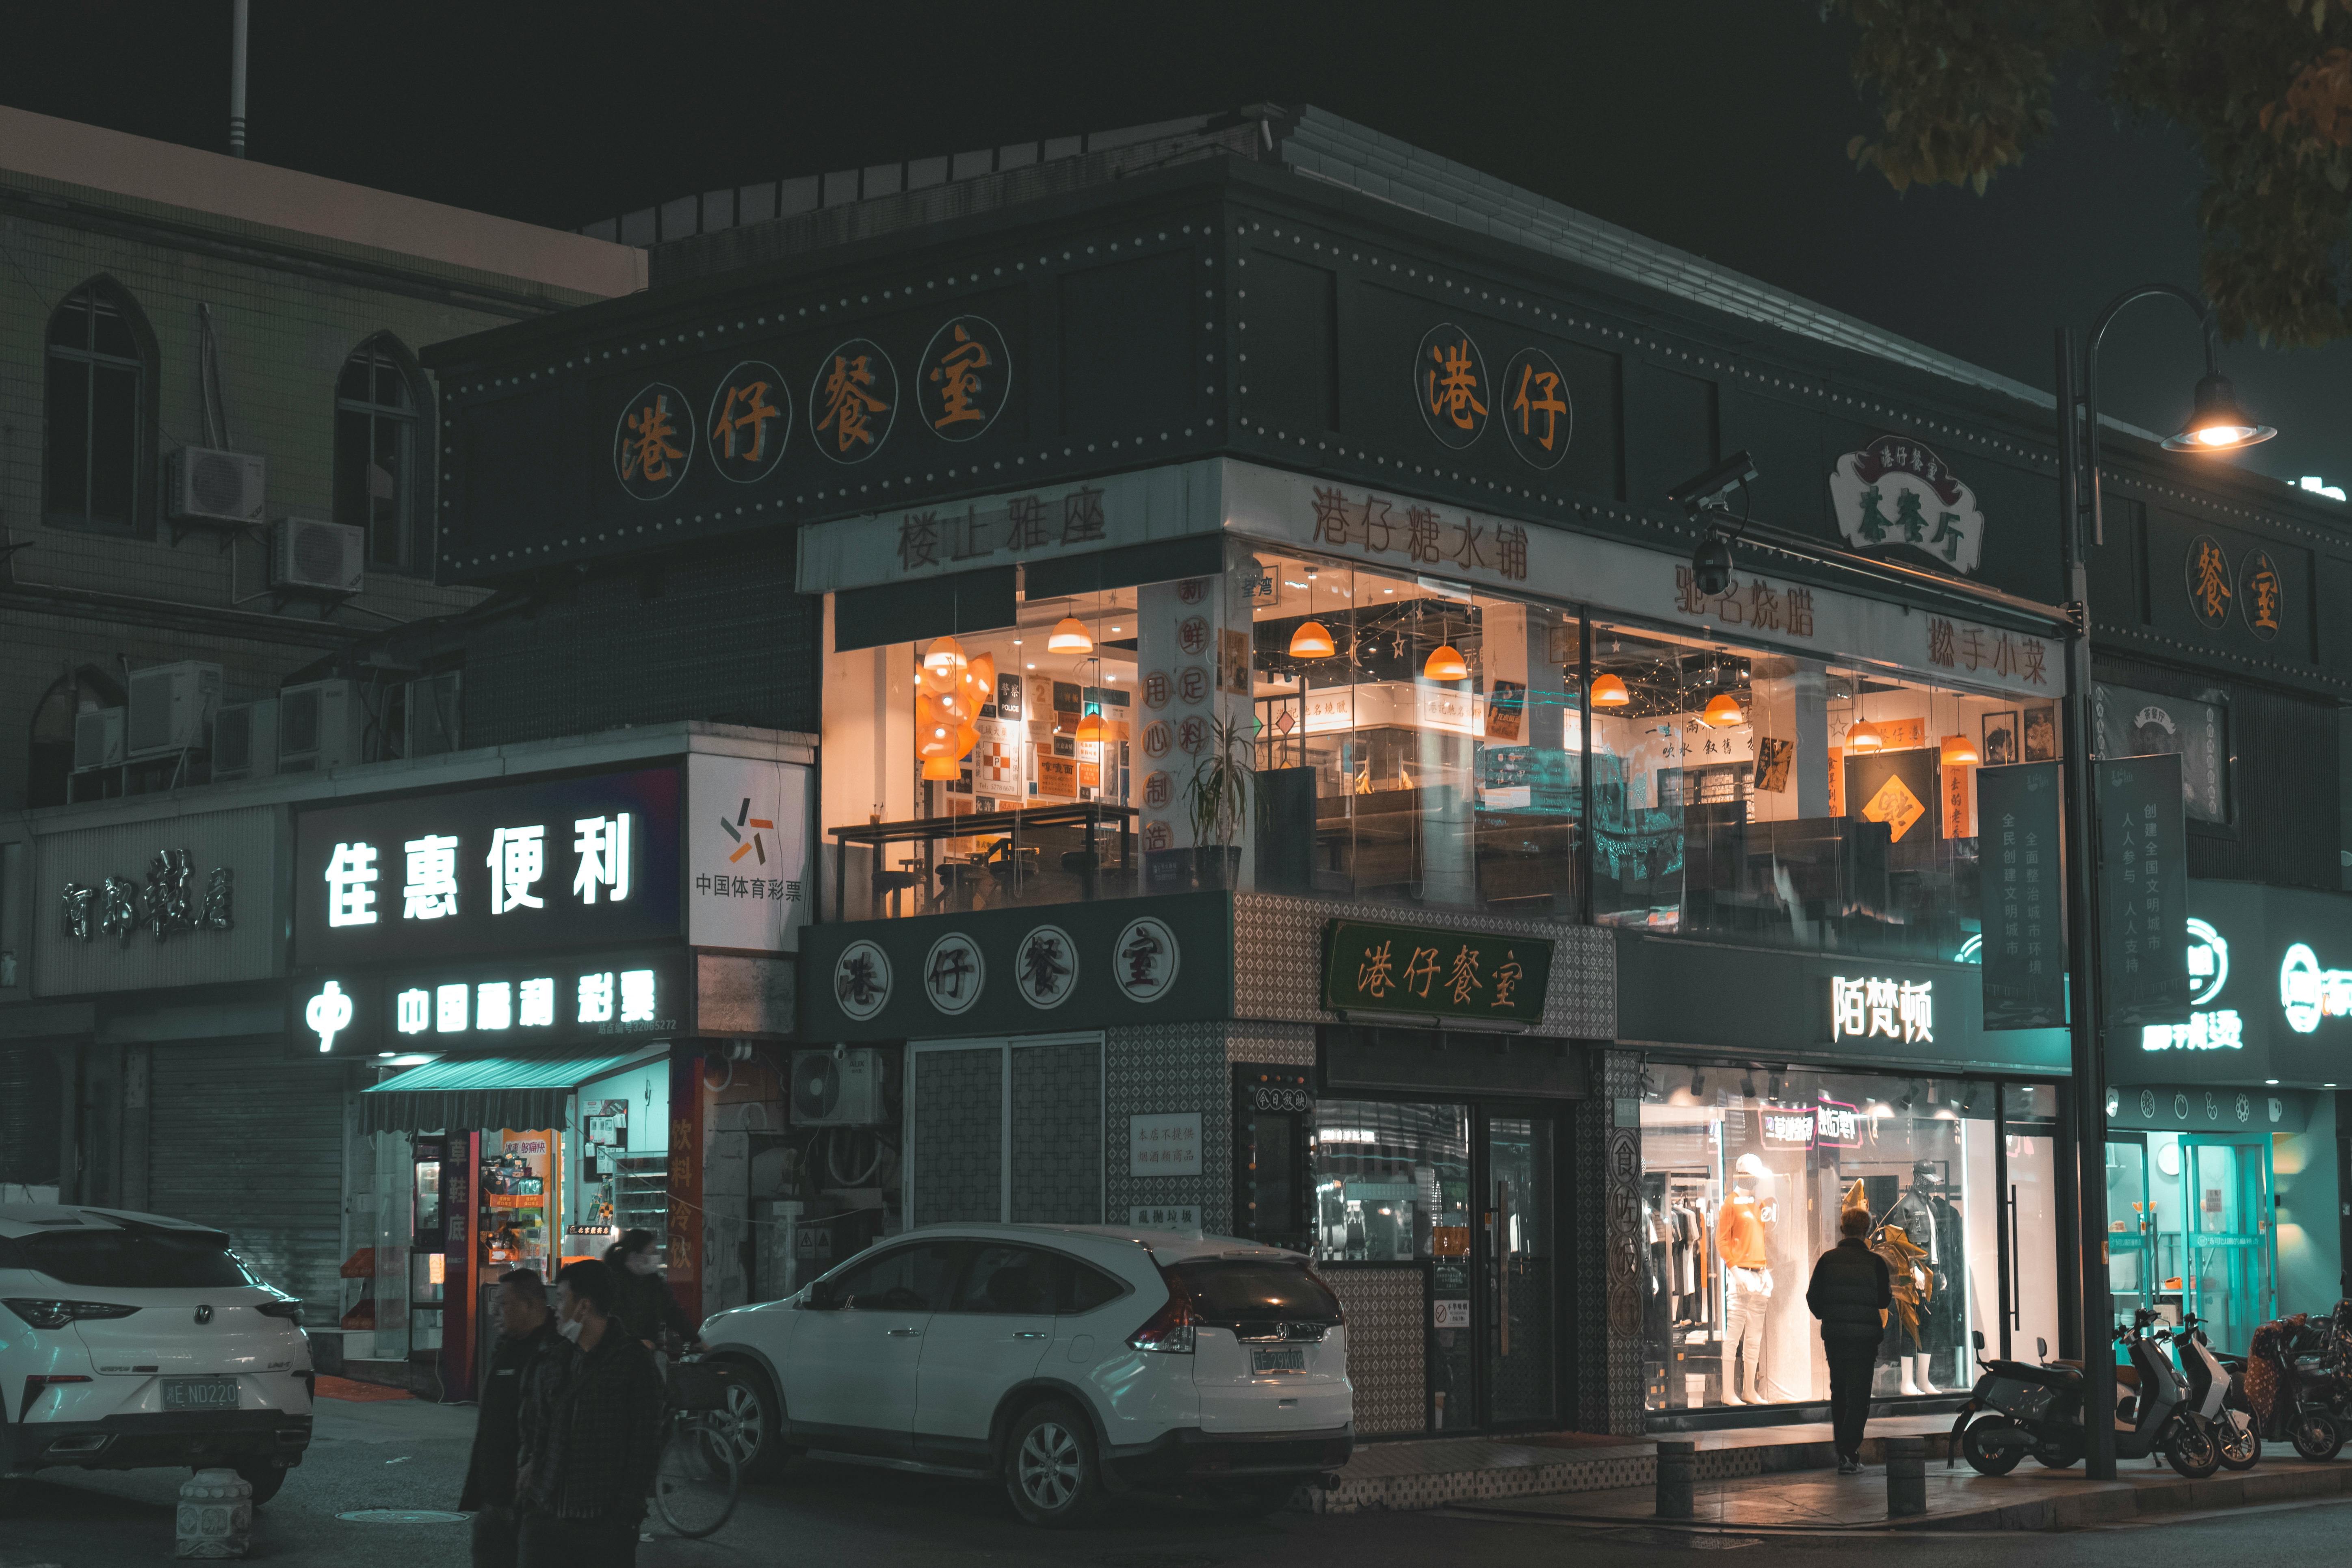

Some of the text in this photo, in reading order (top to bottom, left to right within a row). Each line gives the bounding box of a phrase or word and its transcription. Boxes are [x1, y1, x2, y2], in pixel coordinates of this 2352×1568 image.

[622, 324, 992, 482] 港仔餐室
[1427, 338, 1567, 451] 港仔
[1881, 445, 1938, 481] 港仔餐室
[897, 487, 1106, 571] 楼上雅座
[1312, 486, 1528, 580] 港仔糖水铺
[1858, 485, 1964, 562] 茶餐厅
[2196, 541, 2278, 630] 餐室
[1001, 682, 1019, 697] 警察
[1036, 684, 1046, 702] 2
[2144, 708, 2165, 723] 茶餐厅
[995, 757, 1000, 766] P
[1145, 675, 1167, 851] 用心制造
[325, 812, 630, 927] 佳惠便利
[696, 872, 801, 903] 中国体育彩票
[2002, 813, 2018, 955] 全民创建文明城市
[2025, 832, 2042, 975] 全面整治城市环境
[2122, 813, 2138, 972] 人人参与 人人支持
[2143, 803, 2160, 950] 创建全国文明城市
[839, 926, 1163, 1005] 港仔餐室
[1358, 940, 1523, 1008] 港仔餐室
[598, 1020, 676, 1035] 站点编号32065272
[1832, 976, 1933, 1044] 陌梵顿
[1139, 1128, 1194, 1141] 本店不提供
[1258, 1090, 1305, 1108] 今日放映
[448, 1139, 467, 1242] 草鞋底
[670, 1119, 692, 1269] 饮料冷饮
